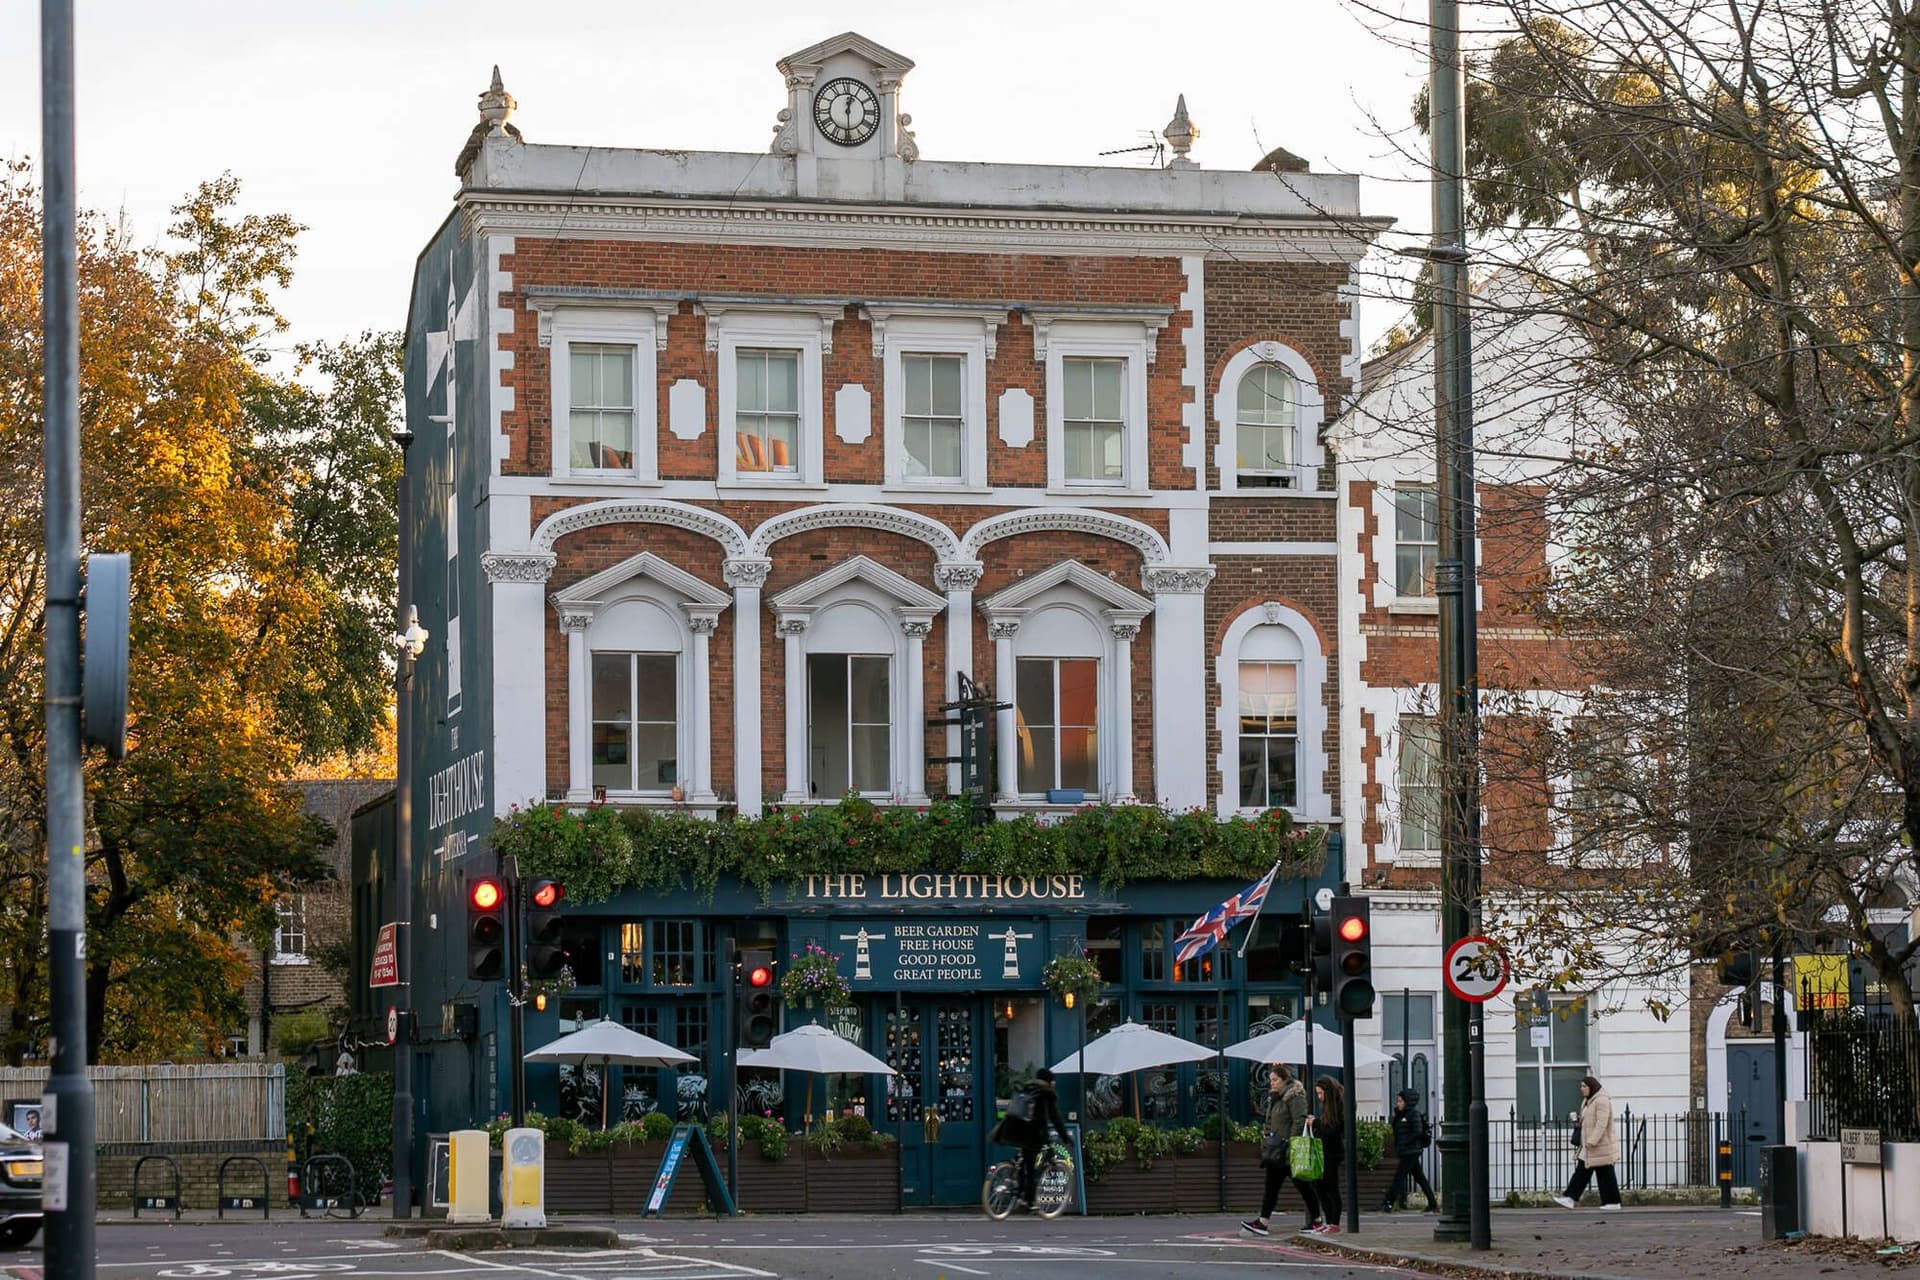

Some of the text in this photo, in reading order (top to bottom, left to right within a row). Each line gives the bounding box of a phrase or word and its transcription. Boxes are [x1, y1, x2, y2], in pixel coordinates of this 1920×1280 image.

[429, 750, 485, 830] LIGHTHOUSE
[806, 873, 1086, 899] THE LIGHTHOUSE
[894, 926, 979, 937] BEER GARDEN
[900, 939, 974, 951] FREE HOUSE
[898, 954, 976, 965] GOOD FOOD
[894, 968, 982, 980] GREAT PEOPLE
[1455, 956, 1500, 981] 20
[832, 1022, 862, 1042] ARDEN
